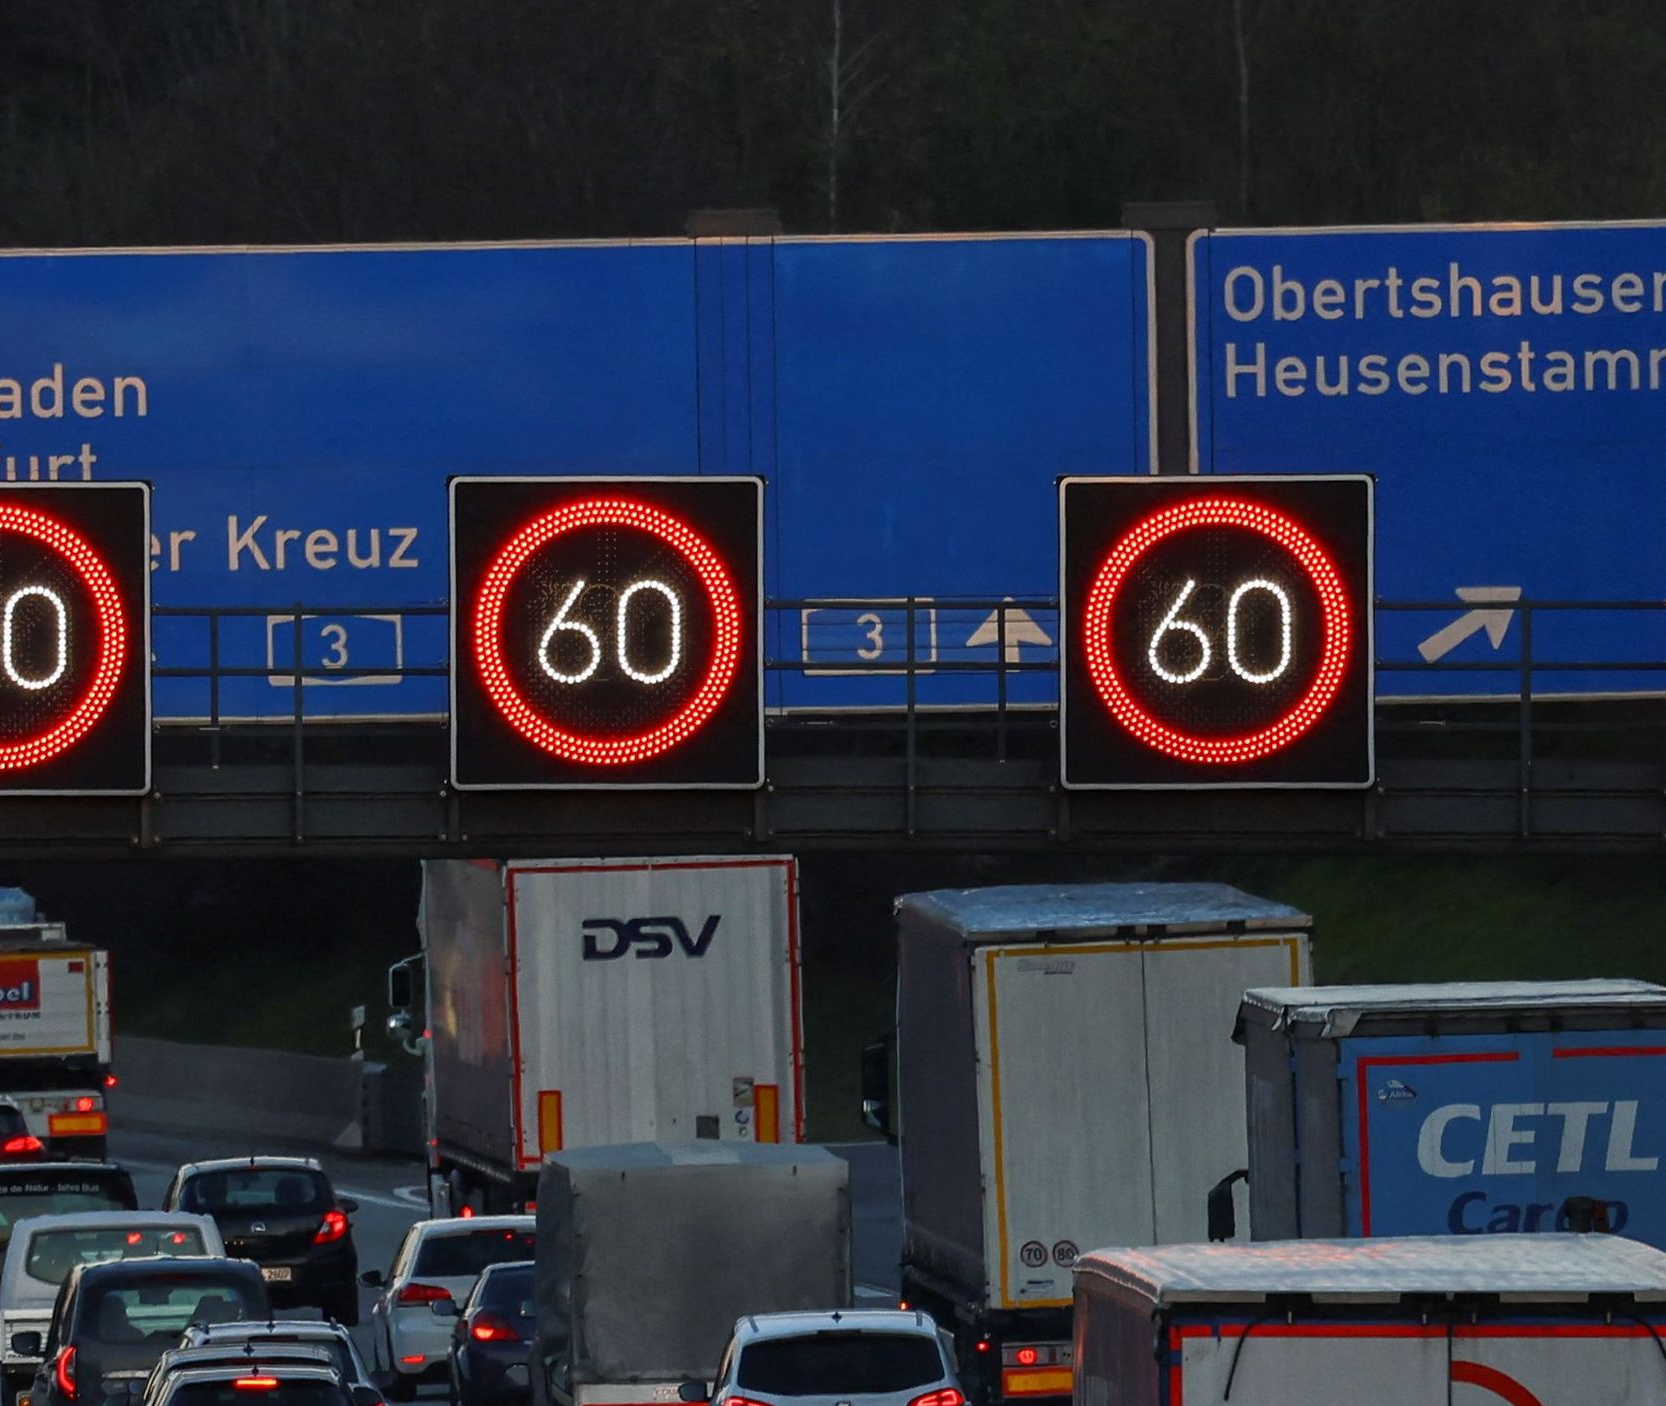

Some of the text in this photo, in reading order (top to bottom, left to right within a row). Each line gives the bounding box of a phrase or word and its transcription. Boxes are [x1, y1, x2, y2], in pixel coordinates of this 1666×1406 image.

[227, 515, 420, 570] Kreuz
[319, 624, 350, 670] 3
[537, 579, 682, 686] 60
[856, 613, 885, 662] 3
[1148, 578, 1292, 685] 60
[581, 914, 722, 961] DSV
[1416, 1099, 1660, 1178] CETL
[1447, 1192, 1629, 1236] Caro
[1026, 1248, 1043, 1260] 70
